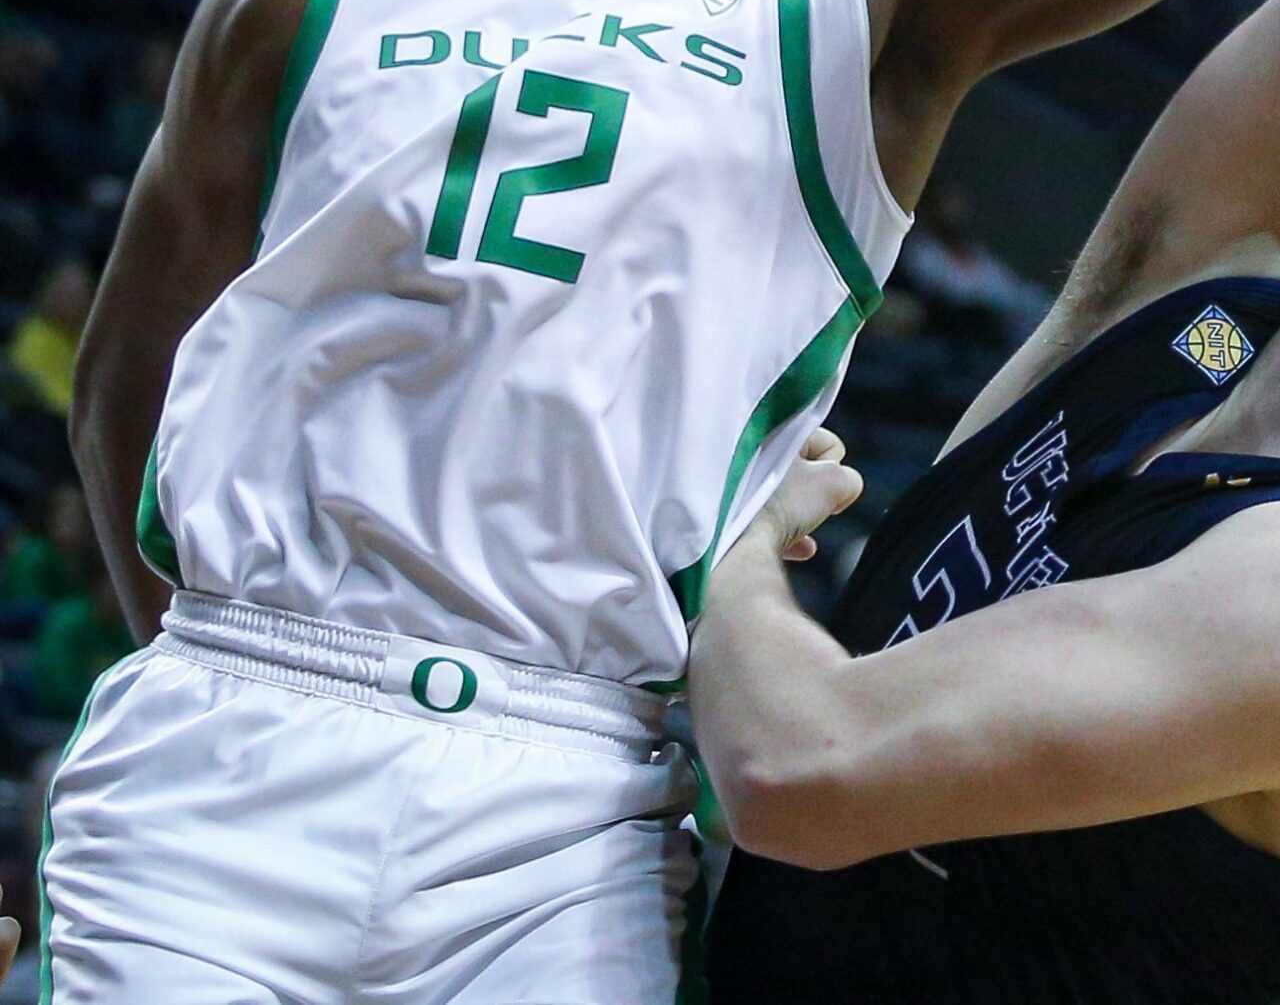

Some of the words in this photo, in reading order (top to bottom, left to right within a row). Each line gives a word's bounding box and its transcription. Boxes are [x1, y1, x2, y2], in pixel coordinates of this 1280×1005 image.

[426, 69, 630, 285] 12
[1207, 322, 1226, 369] NIT
[411, 656, 478, 713] O
